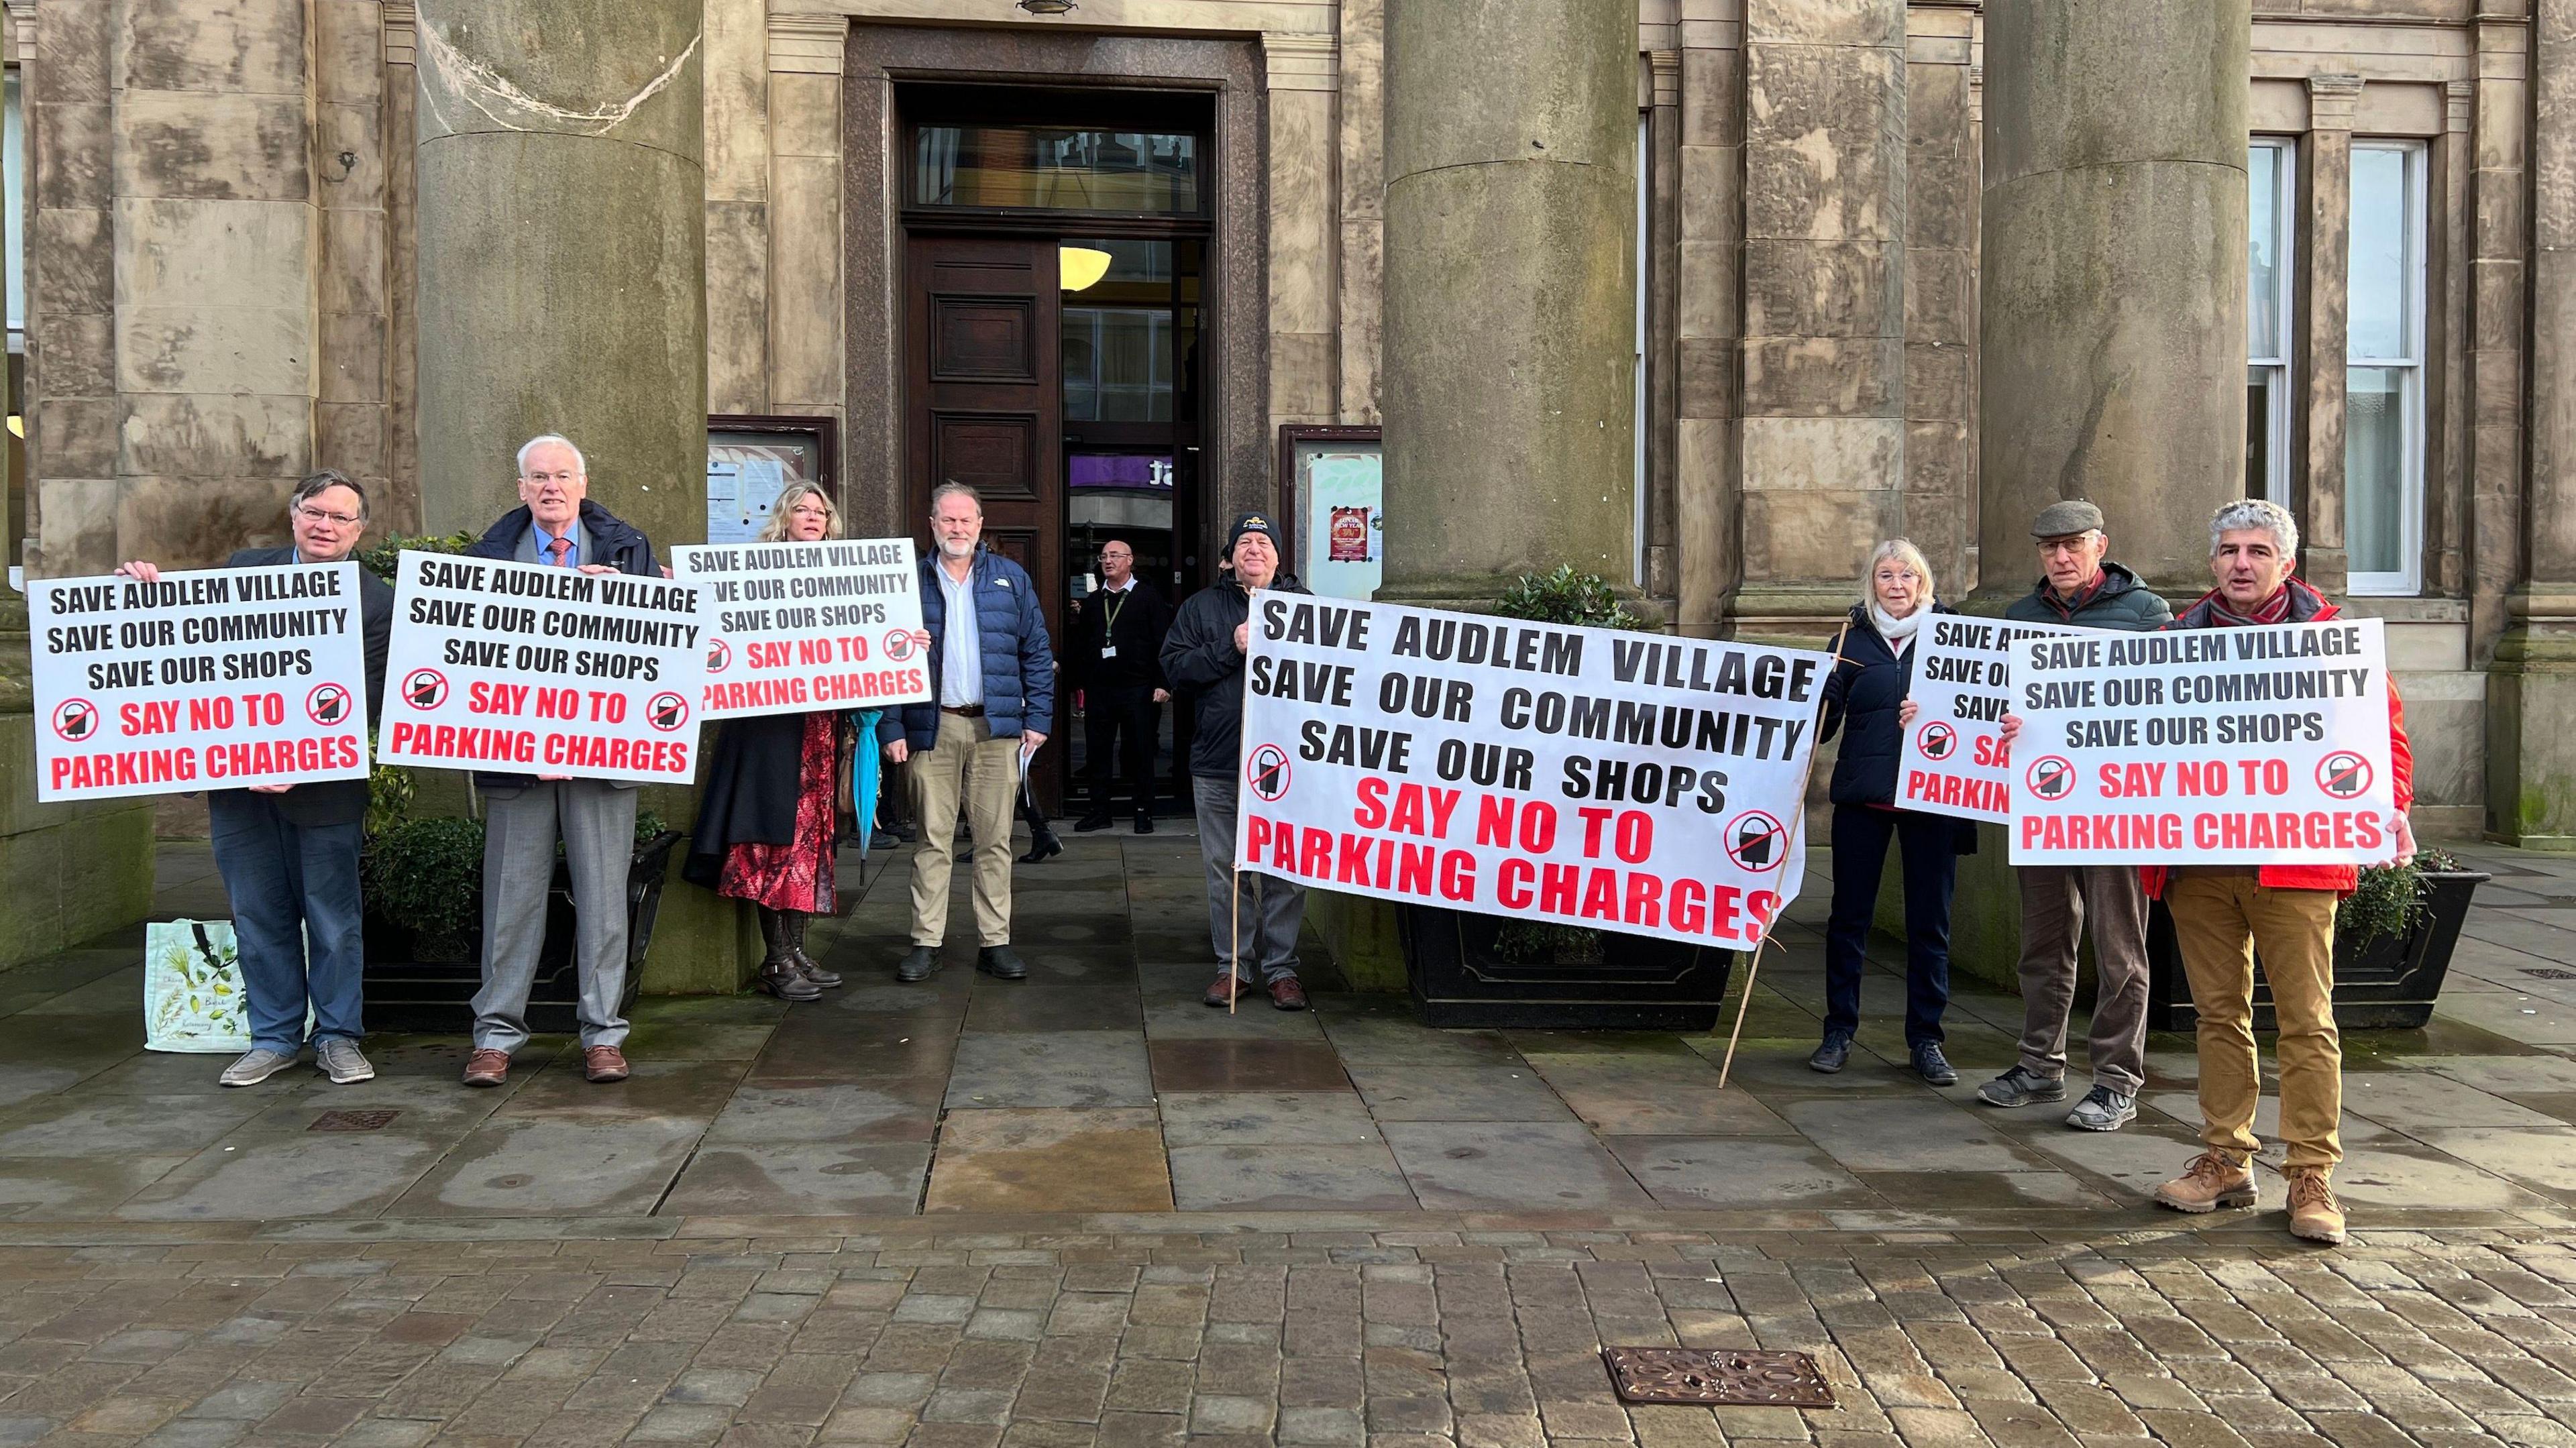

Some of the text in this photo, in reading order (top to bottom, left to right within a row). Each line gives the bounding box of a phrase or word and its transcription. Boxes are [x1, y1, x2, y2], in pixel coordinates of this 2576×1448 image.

[690, 545, 902, 572] SAVE AUDLEM VILLAGE
[51, 571, 340, 614] SAVE AUDLEM VILLAGE
[419, 561, 698, 613] SAVE AUDLEM VILLAGE
[704, 573, 908, 602] VE OUR COMMUNITY
[48, 608, 347, 653] SAVE OUR COMMUNITY
[410, 598, 699, 649] SAVE OUR COMMUNITY
[721, 604, 885, 632] SAVE OUR SHOPS
[1935, 622, 1992, 649] SAVE
[89, 649, 311, 689] SAVE OUR SHOPS
[444, 639, 658, 681] SAVE OUR SHOPS
[748, 636, 867, 668] SAY NO TO
[1264, 600, 1816, 702] SAVE AUDLEM VILLAGE
[1926, 656, 1982, 684] SAVE
[2031, 641, 2100, 670] SAVE
[2108, 634, 2226, 666] AUDLEM
[2235, 628, 2360, 659] VILLAGE
[470, 681, 627, 723] SAY NO TO
[814, 670, 922, 701] CHARGES
[2026, 669, 2368, 709] SAVE OUR COMMUNITY
[121, 693, 284, 736] SAY NO TO
[1252, 656, 1807, 761] SAVE OUR COMMUNITY
[392, 722, 687, 773] PARKING CHARGES
[2067, 713, 2323, 748] SAVE OUR SHOPS
[52, 735, 358, 789] PARKING CHARGES
[1299, 720, 1727, 814] SAVE OUR SHOPS
[1974, 735, 2009, 769] SA
[1907, 771, 2009, 814] PARKIN
[2100, 759, 2288, 797] SAY NO TO
[1354, 777, 1653, 864] SAY NO TO
[2023, 812, 2381, 849] PARKING CHARGES
[1247, 815, 1782, 943] PARKING CHARGES
